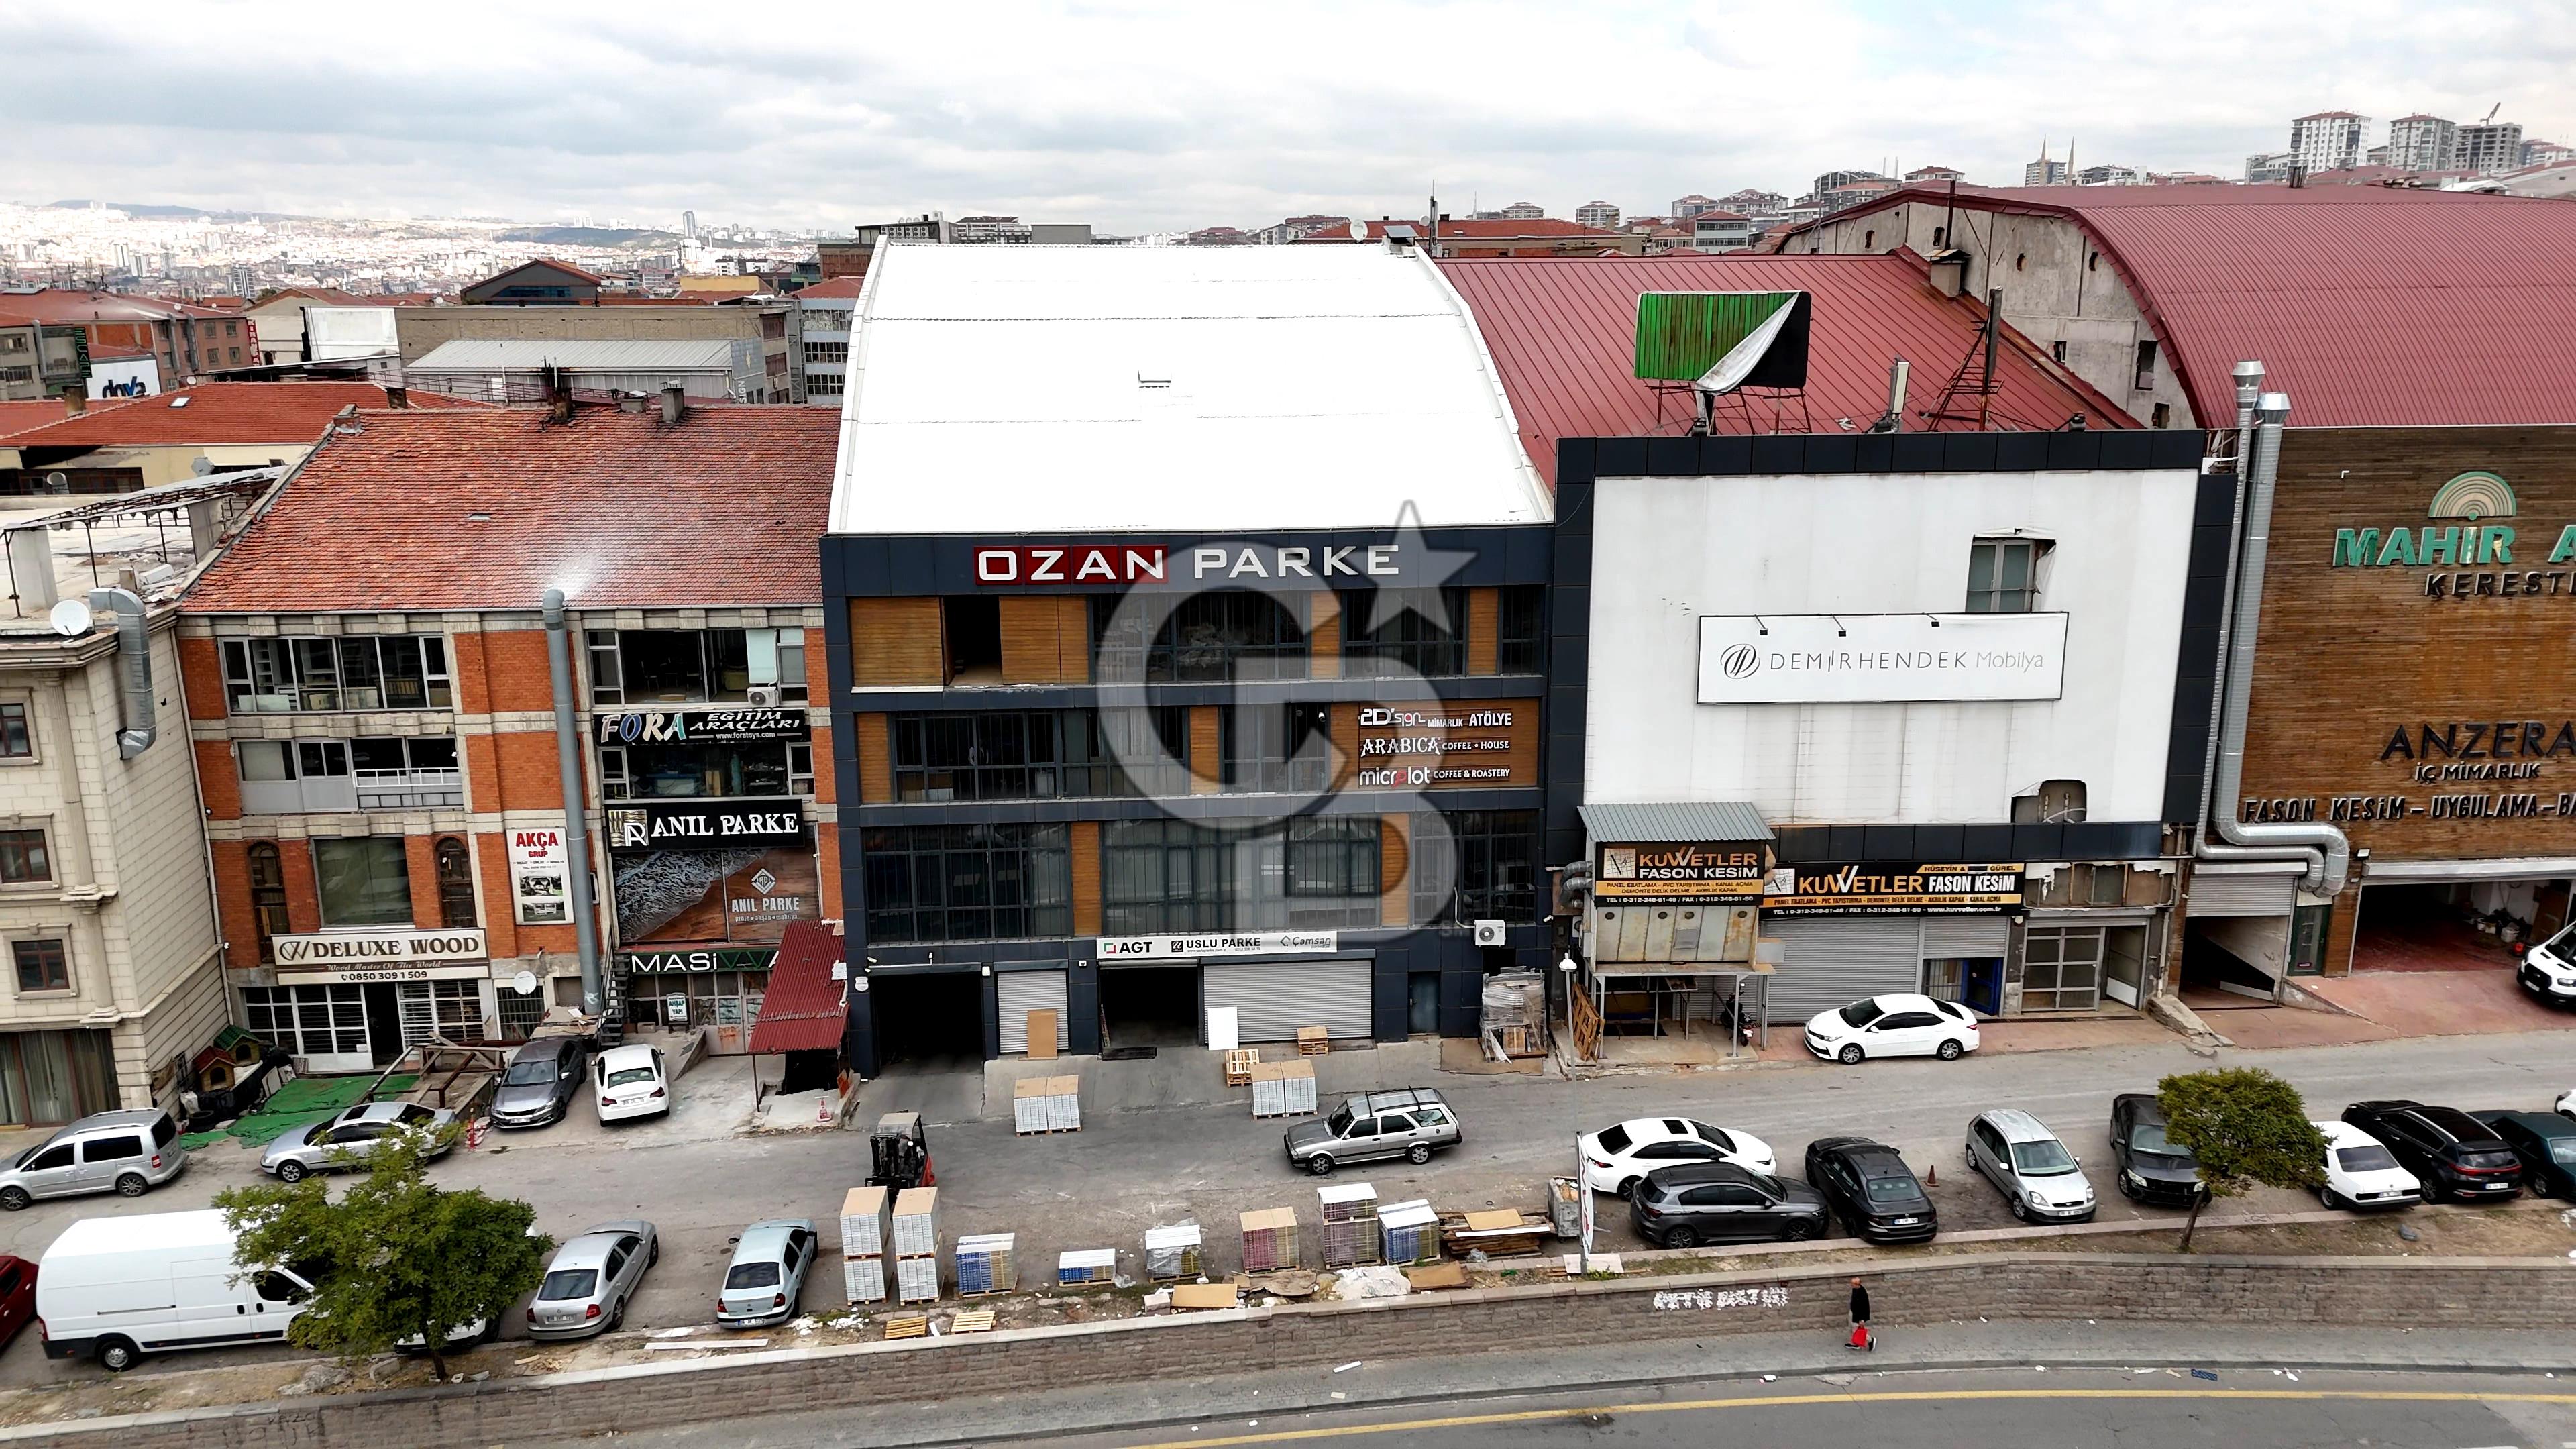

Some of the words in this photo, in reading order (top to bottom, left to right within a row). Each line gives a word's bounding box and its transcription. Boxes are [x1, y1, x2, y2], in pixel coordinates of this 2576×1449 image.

[2332, 526, 2515, 566] MAHIR
[977, 549, 1163, 580] OZAN
[1194, 545, 1399, 578] PARKE
[1976, 651, 2043, 673] Mobilya
[601, 712, 686, 743] FORA
[689, 719, 800, 731] ARAÇLARI
[1428, 717, 1463, 727] MİMARLIK
[1469, 711, 1512, 727] ATÖLYE
[716, 731, 775, 740] www.foratoys.com
[2381, 721, 2576, 761] ANZERA
[1360, 737, 1440, 757] ARABICA
[1442, 741, 1472, 750] COFFEE
[1481, 741, 1509, 749] HOUSE
[1434, 770, 1462, 778] COFFEE
[1464, 769, 1470, 778] &
[1472, 769, 1510, 778] ROASTERY
[2441, 760, 2541, 781] MİMARLIK
[2243, 798, 2316, 823] FASON
[2431, 794, 2537, 819] UYGULAMA
[651, 816, 714, 837] ANIL
[720, 813, 799, 835] PARKE
[516, 832, 559, 851] AKÇA
[1639, 867, 1698, 879] FASON
[1929, 875, 1971, 892] FASON
[731, 898, 757, 912] ANIL
[762, 897, 800, 911] PARKE
[311, 939, 402, 958] DELUXE
[408, 936, 479, 955] WOOD
[1119, 941, 1152, 953] AGT
[1186, 939, 1218, 948] USLU
[1222, 938, 1261, 947] PARKE
[1292, 936, 1331, 947] Çamsan
[353, 963, 380, 971] Master
[382, 962, 393, 970] Of
[414, 960, 441, 968] World
[349, 973, 376, 981] 0850
[378, 972, 398, 980] 309
[408, 971, 427, 979] 509
